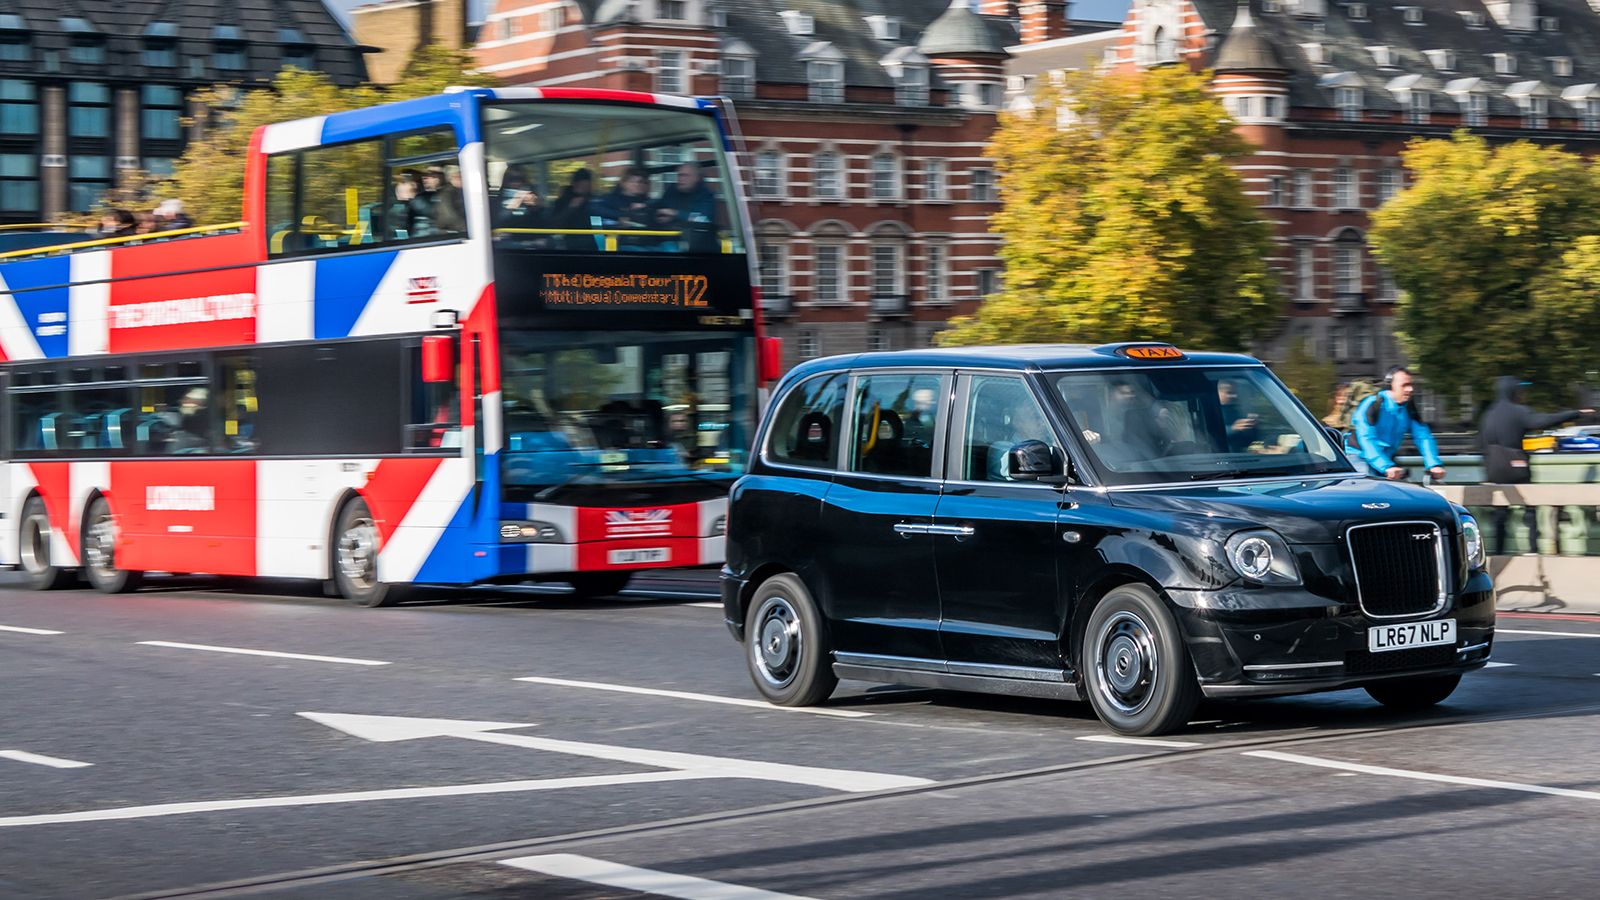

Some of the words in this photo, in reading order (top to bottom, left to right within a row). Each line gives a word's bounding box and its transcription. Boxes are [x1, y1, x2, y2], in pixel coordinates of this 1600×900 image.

[630, 274, 671, 288] Tour
[1133, 348, 1179, 357] TAXI
[1376, 627, 1416, 648] LR67
[1420, 622, 1450, 642] NLP
